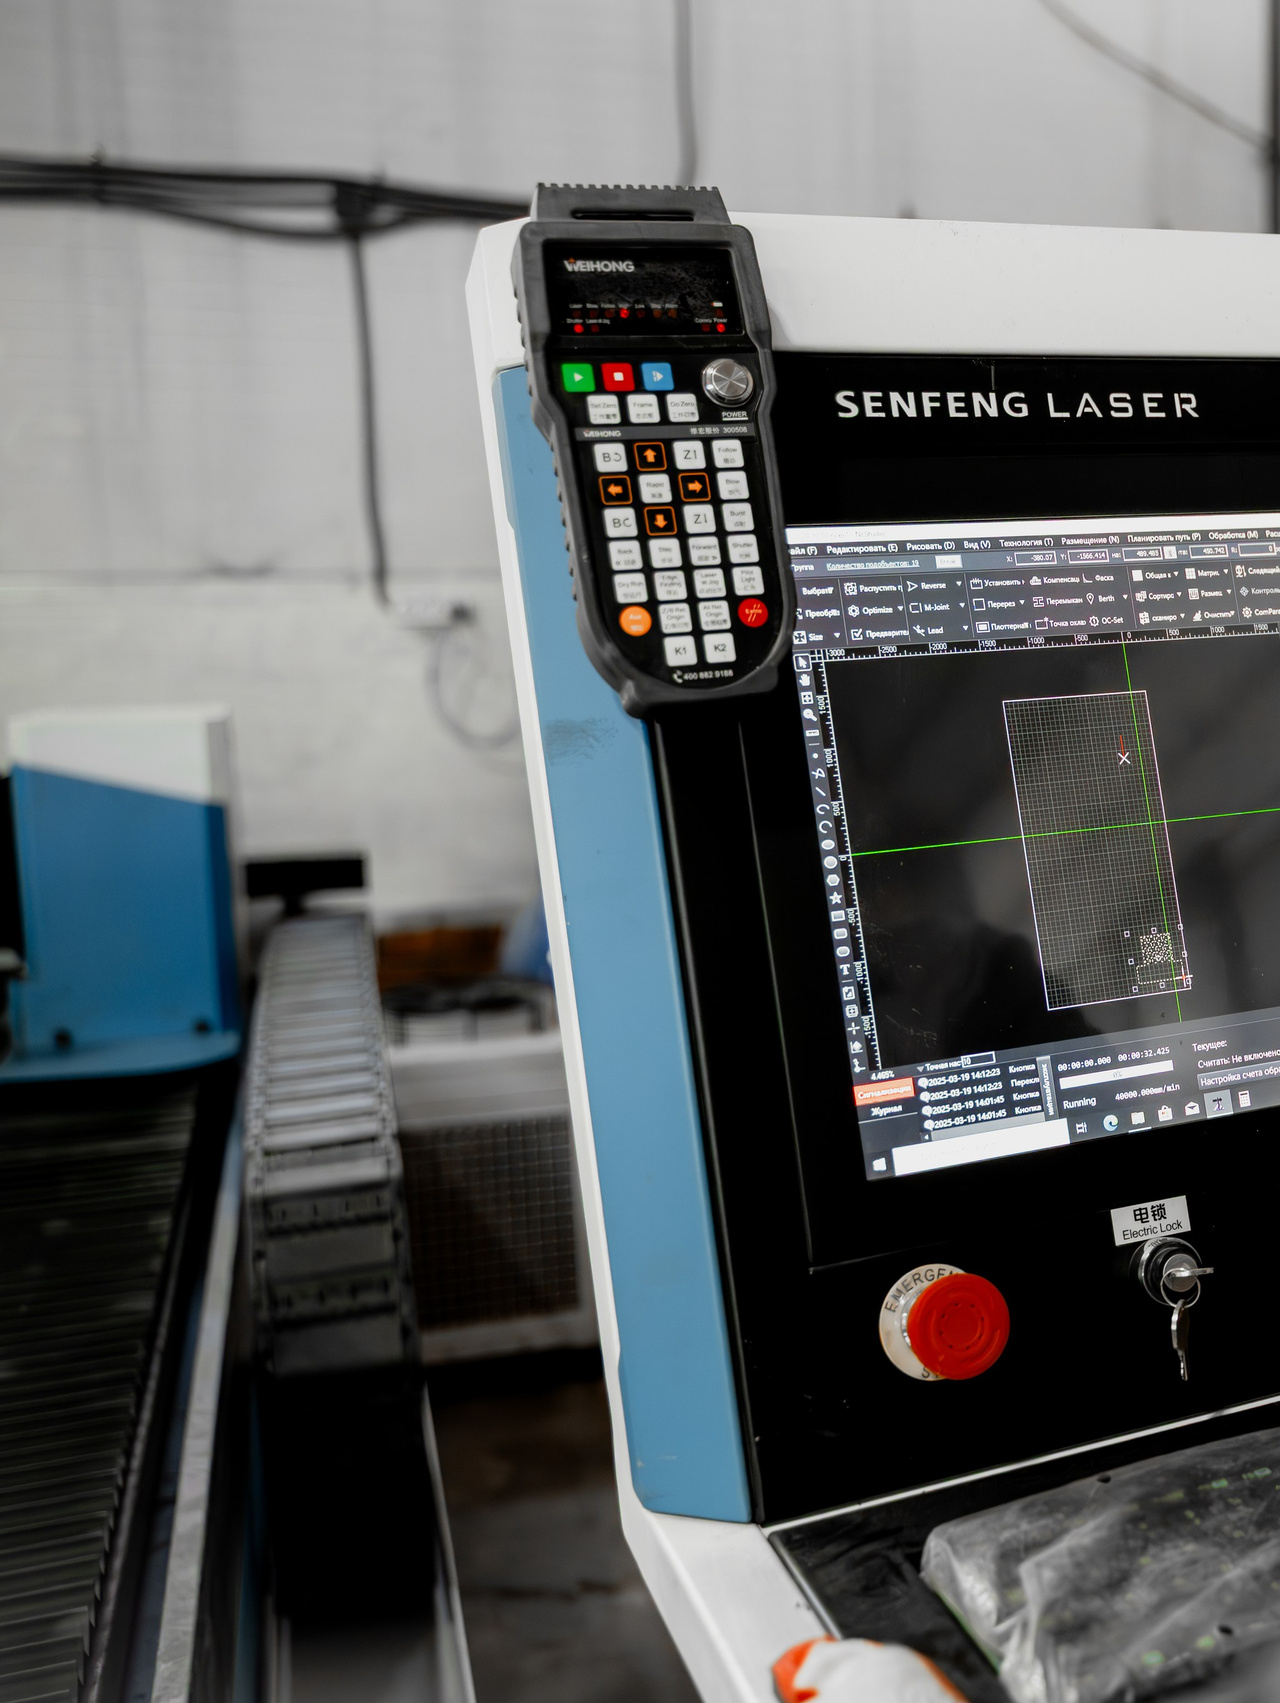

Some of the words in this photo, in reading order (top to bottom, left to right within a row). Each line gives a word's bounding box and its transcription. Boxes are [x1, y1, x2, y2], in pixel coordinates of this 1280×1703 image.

[564, 260, 634, 272] WEIHONG
[835, 391, 1029, 418] SENFENG
[1047, 392, 1199, 418] LASER
[584, 430, 621, 438] WEIHONG
[723, 426, 747, 434] 300508
[1128, 535, 1174, 543] Планировать
[1192, 533, 1201, 541] (P)
[1209, 531, 1245, 540] Обработка
[1247, 530, 1258, 539] (M)
[1000, 538, 1042, 548] Технология
[1044, 538, 1053, 546] (T)
[1062, 537, 1107, 545] Размещение
[1109, 536, 1120, 544] (N)
[692, 543, 717, 551] Forward
[827, 545, 886, 554] Редактировать
[907, 542, 939, 551] Рисовать
[941, 541, 955, 550] (D)
[964, 541, 978, 550] Вид
[980, 541, 991, 549] (V)
[789, 547, 805, 555] айл
[807, 546, 817, 555] (F)
[1077, 552, 1106, 560] -1566.414
[1145, 571, 1165, 579] Общая
[1248, 566, 1279, 575] Следящий
[1095, 574, 1114, 582] Фаска
[984, 579, 1021, 587] Установить
[859, 584, 896, 593] Распустить
[1251, 587, 1280, 595] Контроль
[924, 603, 950, 611] M-Joint
[988, 601, 1015, 609] Перерез
[863, 606, 893, 615] Optimize
[1050, 620, 1068, 628] Точка
[1101, 617, 1124, 625] OC-Set
[928, 626, 944, 634] Lead
[809, 633, 823, 641] Size
[675, 647, 686, 656] K1
[714, 644, 726, 652] K2
[684, 672, 697, 680] 400
[1192, 1040, 1227, 1052] Текущее:
[1058, 1057, 1111, 1072] 00:00:00.000
[1118, 1047, 1170, 1061] 00:00:32.425
[1197, 1057, 1230, 1069] Считать:
[1232, 1055, 1242, 1064] Не
[929, 1073, 970, 1086] 2025-03-19
[971, 1068, 1001, 1081] 14:12:23
[1009, 1063, 1036, 1073] Кнопка
[1200, 1072, 1241, 1087] Настройка
[1242, 1069, 1262, 1080] счета
[931, 1087, 972, 1100] 2025-03-19
[973, 1082, 1003, 1095] 14:12:23
[932, 1101, 973, 1115] 2025-03-19
[974, 1096, 1004, 1109] 14:01:45
[1013, 1091, 1040, 1101] Кнопка
[1063, 1097, 1096, 1110] Running
[871, 1105, 902, 1116] Журнал
[935, 1115, 976, 1129] 2025-03-19
[977, 1110, 1007, 1123] 14:01:45
[1015, 1105, 1041, 1115] Кнопка
[1133, 1203, 1167, 1224] 电锁
[1122, 1225, 1158, 1240] Electric
[1160, 1220, 1183, 1232] Lock
